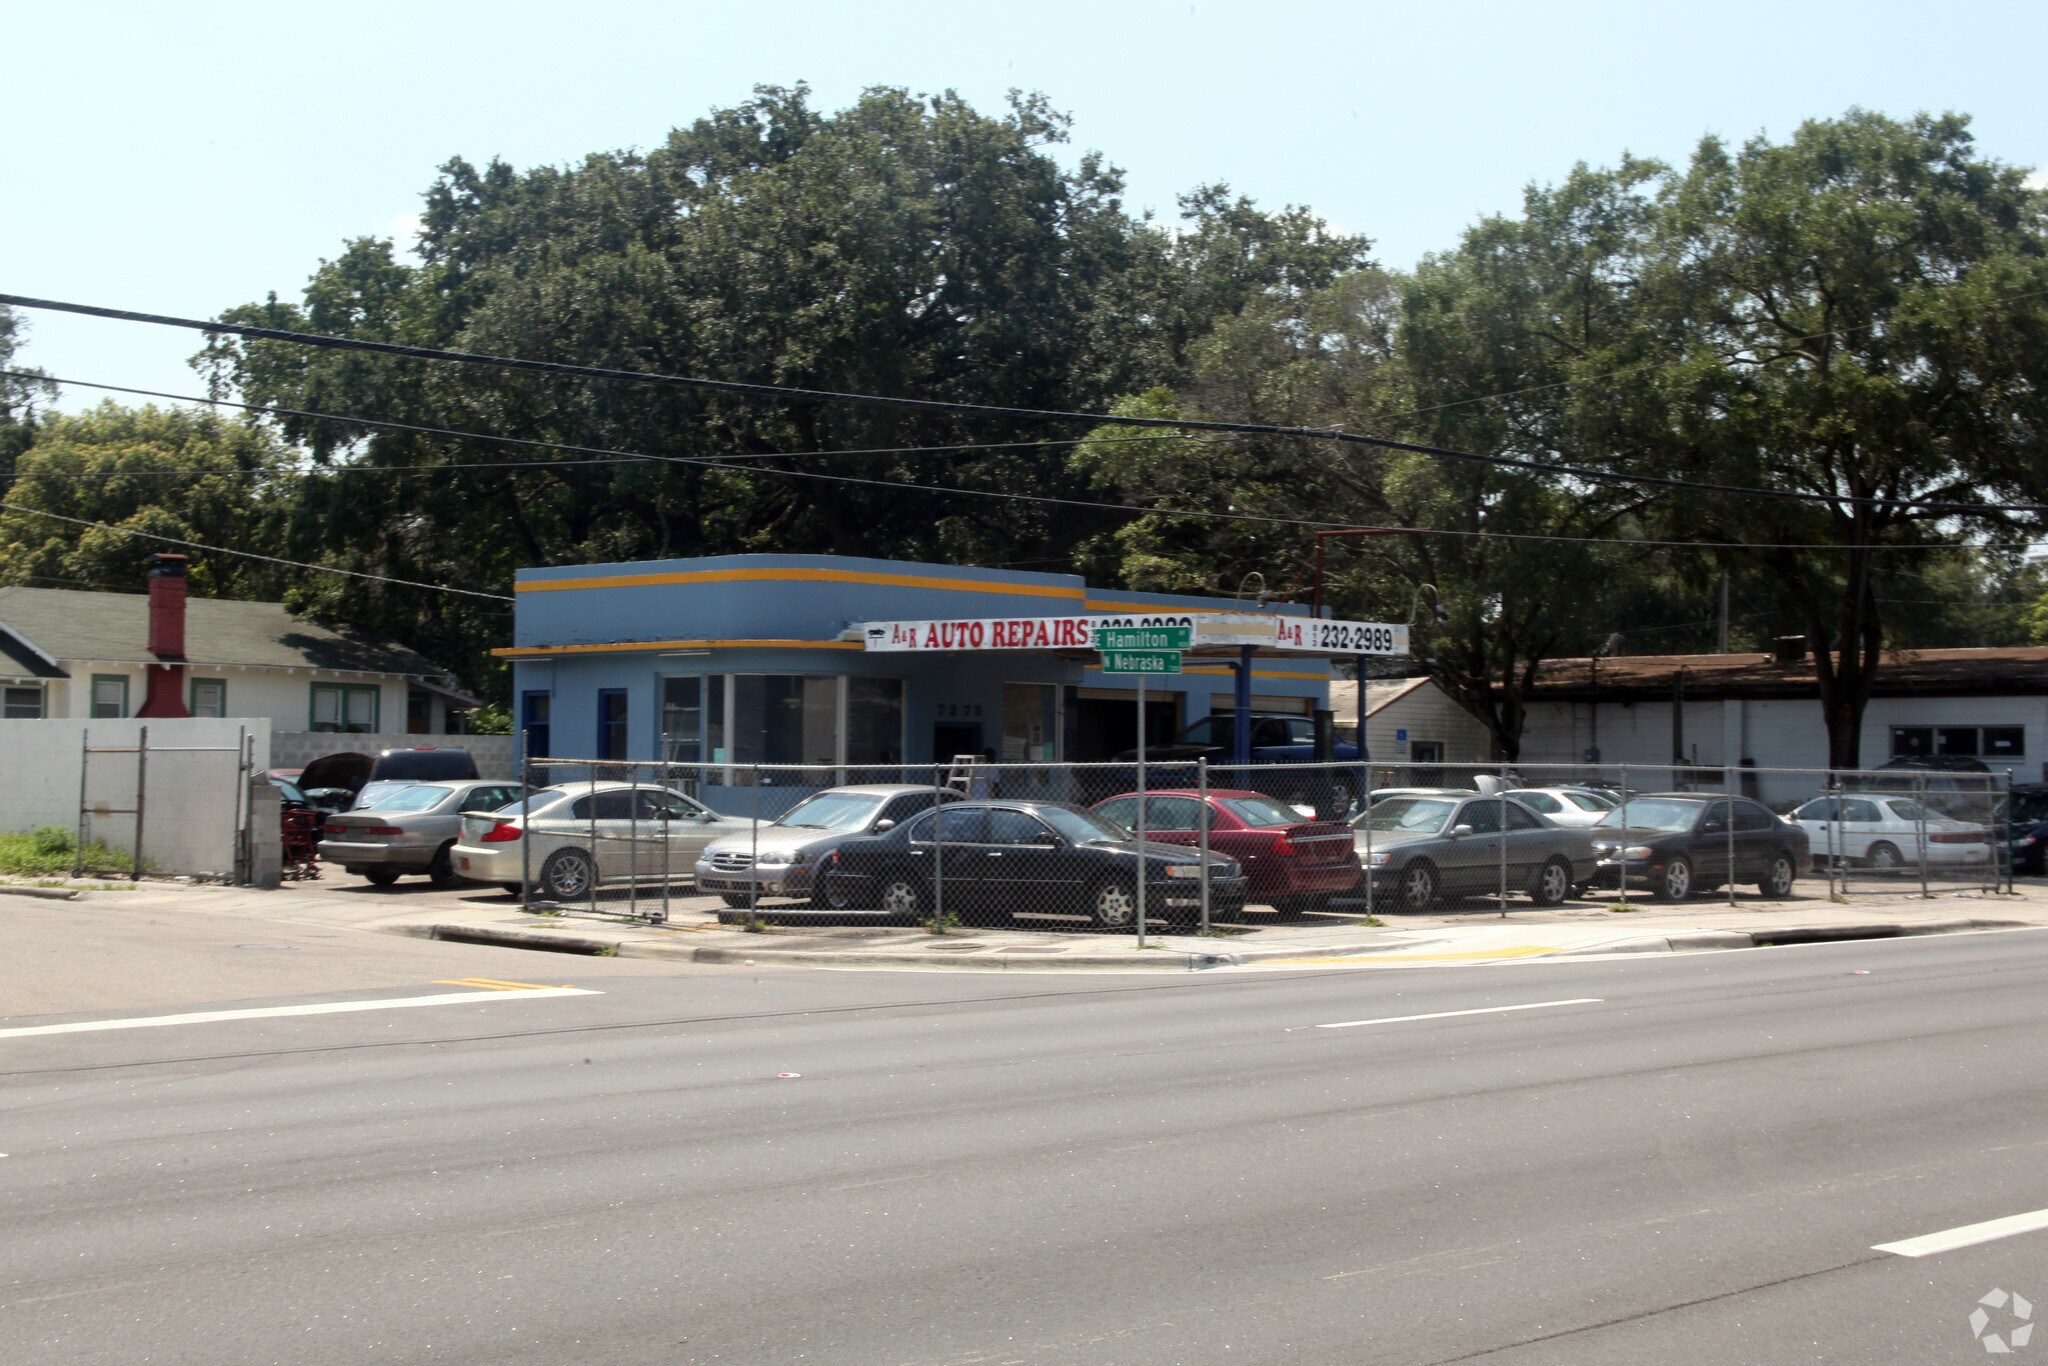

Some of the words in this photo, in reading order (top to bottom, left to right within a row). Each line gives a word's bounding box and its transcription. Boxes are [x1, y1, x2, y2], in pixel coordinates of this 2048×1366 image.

[924, 621, 985, 648] AUTO
[991, 619, 1089, 647] REPAIRS
[1095, 633, 1101, 646] E
[1106, 631, 1169, 648] Hamilton
[1104, 655, 1111, 668] N
[1114, 653, 1165, 671] Nebraska
